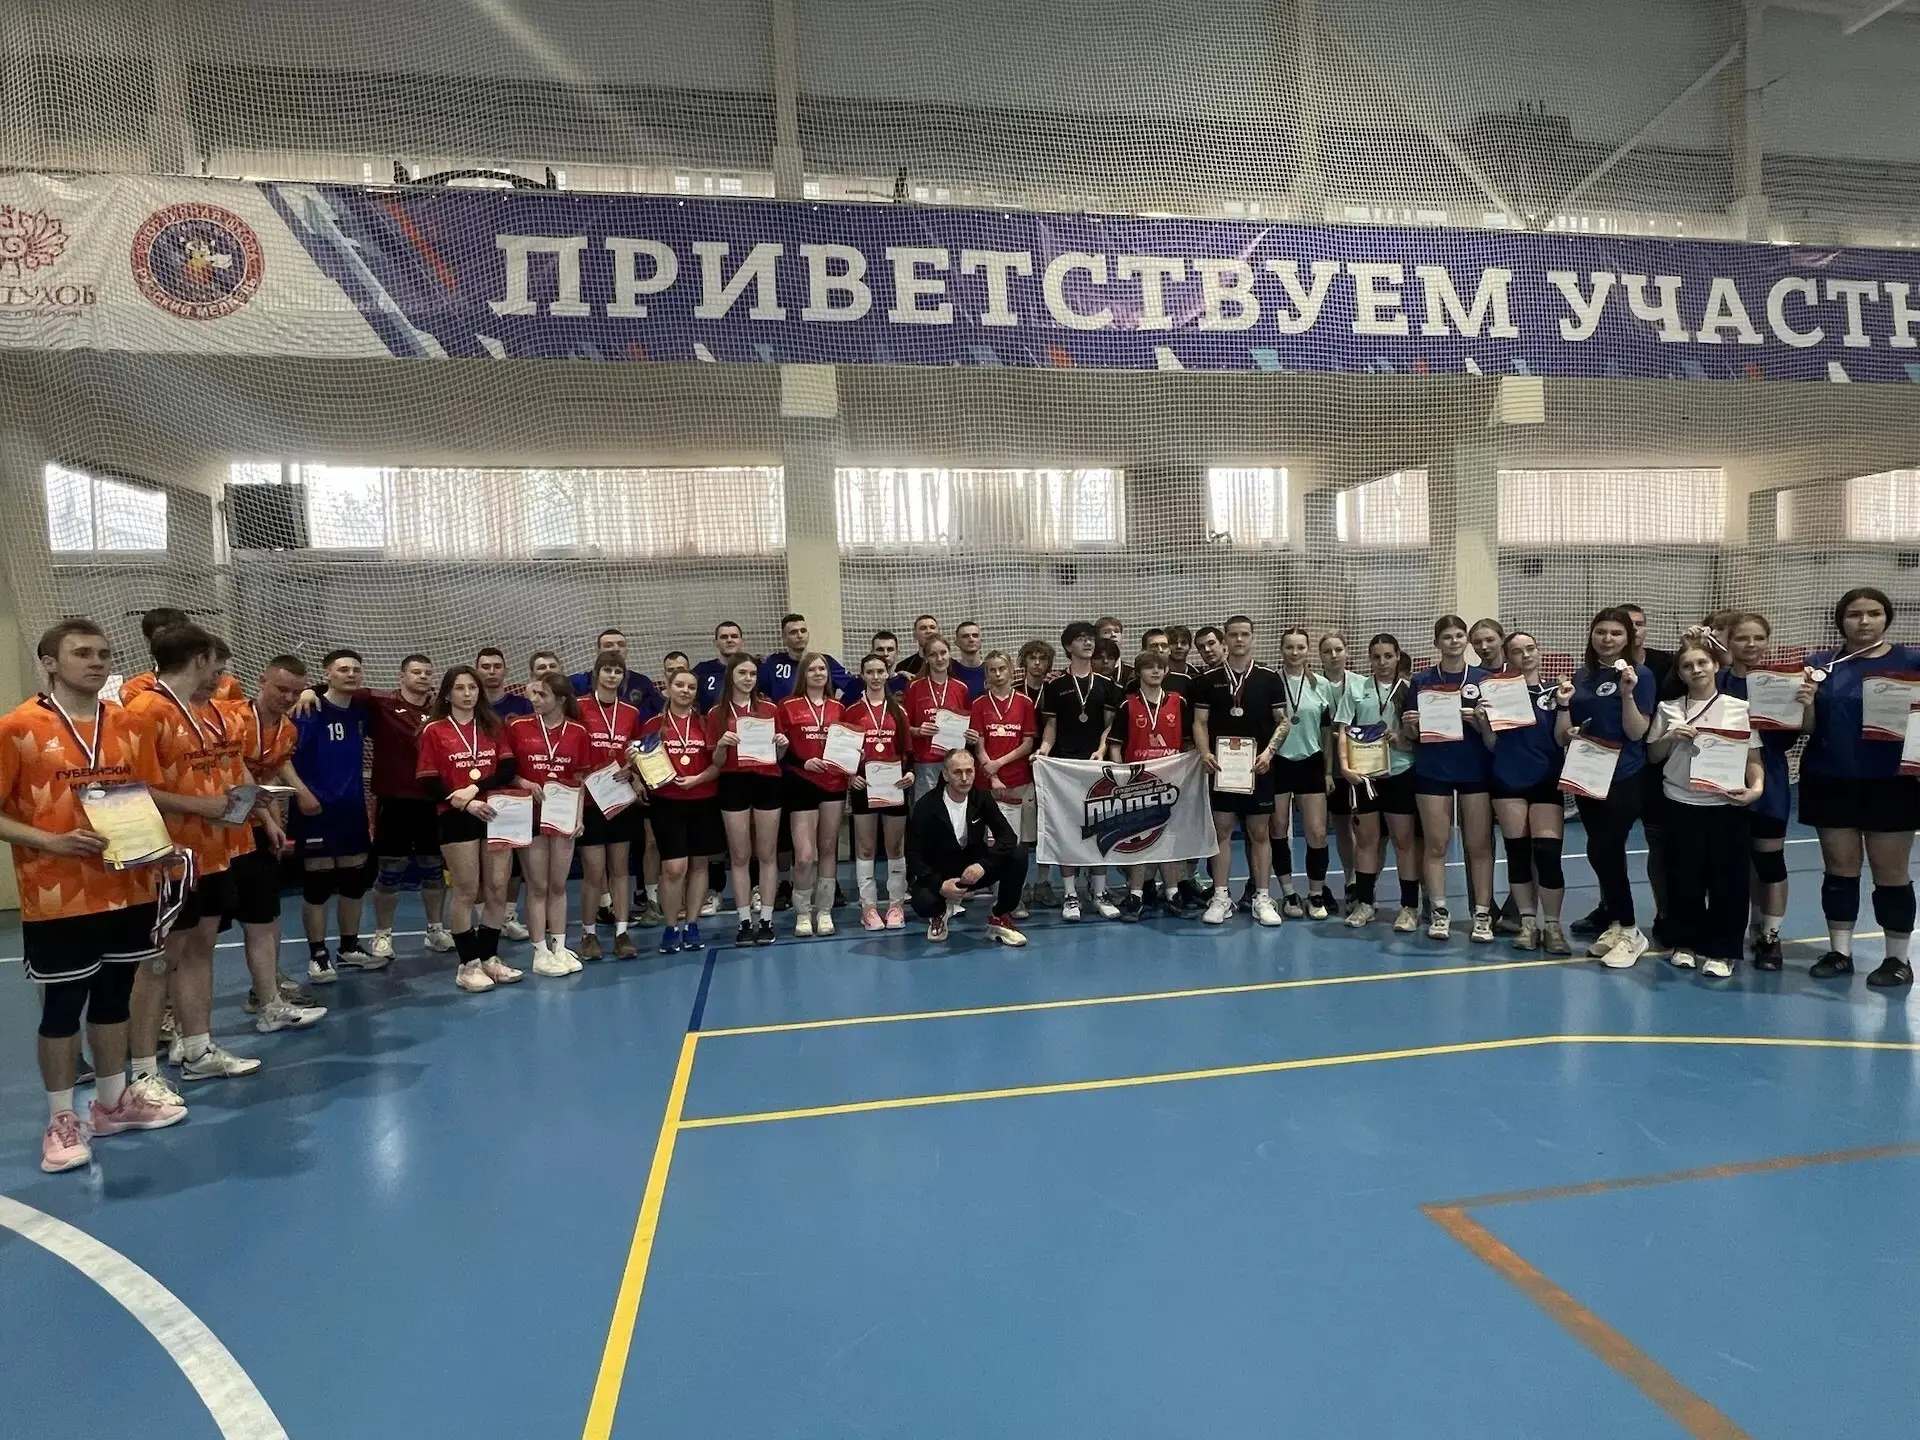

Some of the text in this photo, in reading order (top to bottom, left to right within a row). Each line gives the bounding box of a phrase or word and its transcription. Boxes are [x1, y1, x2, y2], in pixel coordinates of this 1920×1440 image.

[488, 233, 1519, 339] ПРИВЕТСТВУЕМ
[776, 663, 791, 679] 20
[707, 676, 716, 691] 2
[327, 722, 345, 741] 19
